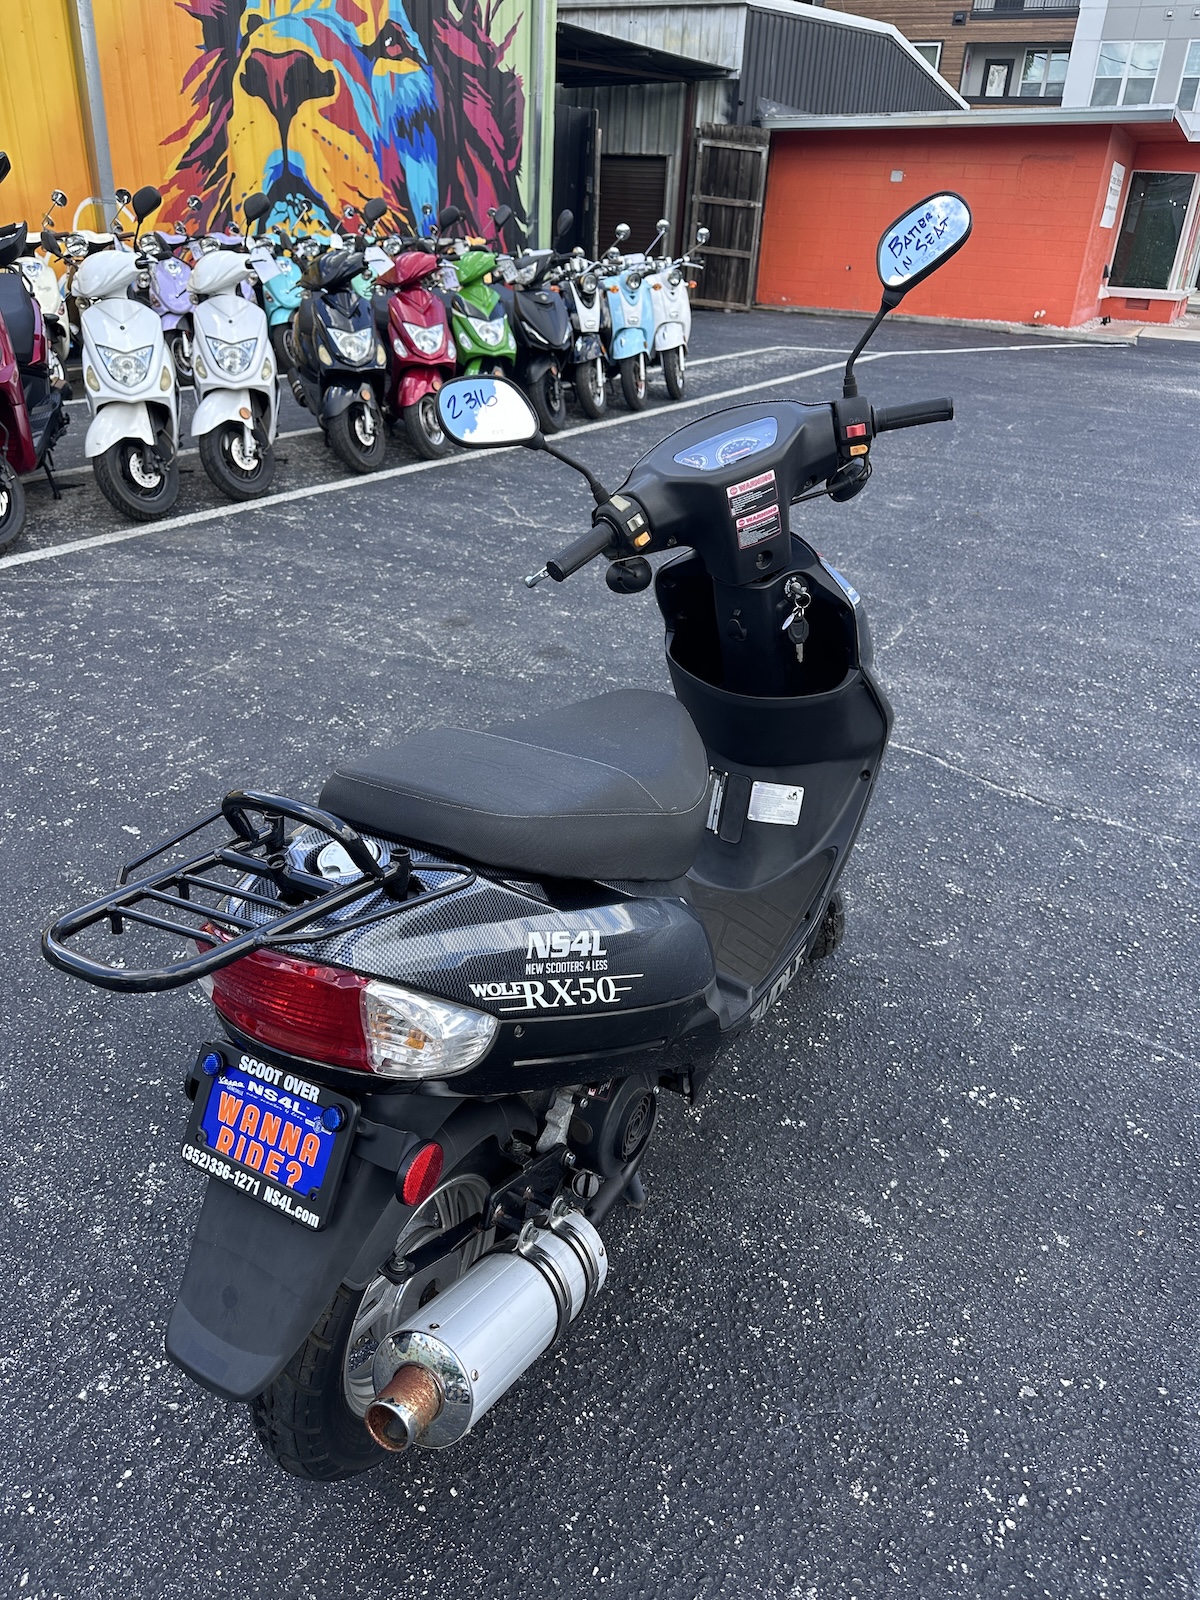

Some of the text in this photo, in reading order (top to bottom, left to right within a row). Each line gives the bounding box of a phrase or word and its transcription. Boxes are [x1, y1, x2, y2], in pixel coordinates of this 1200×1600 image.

[887, 211, 941, 259] BATTER
[894, 216, 949, 277] IN SEAT
[921, 245, 942, 263] DOT
[738, 472, 773, 492] WARNING
[745, 506, 777, 523] WARNING
[525, 930, 607, 959] NS4L
[525, 959, 608, 975] NEW SCOOTERS 4 LESS
[469, 976, 617, 1009] WOLF RX-50
[238, 1055, 320, 1103] SCOOT OVER
[247, 1080, 306, 1117] NS4L
[217, 1090, 321, 1168] WANNA
[215, 1125, 303, 1189] RIDE?
[181, 1143, 320, 1229] (352)336-1271 NS4L.com
